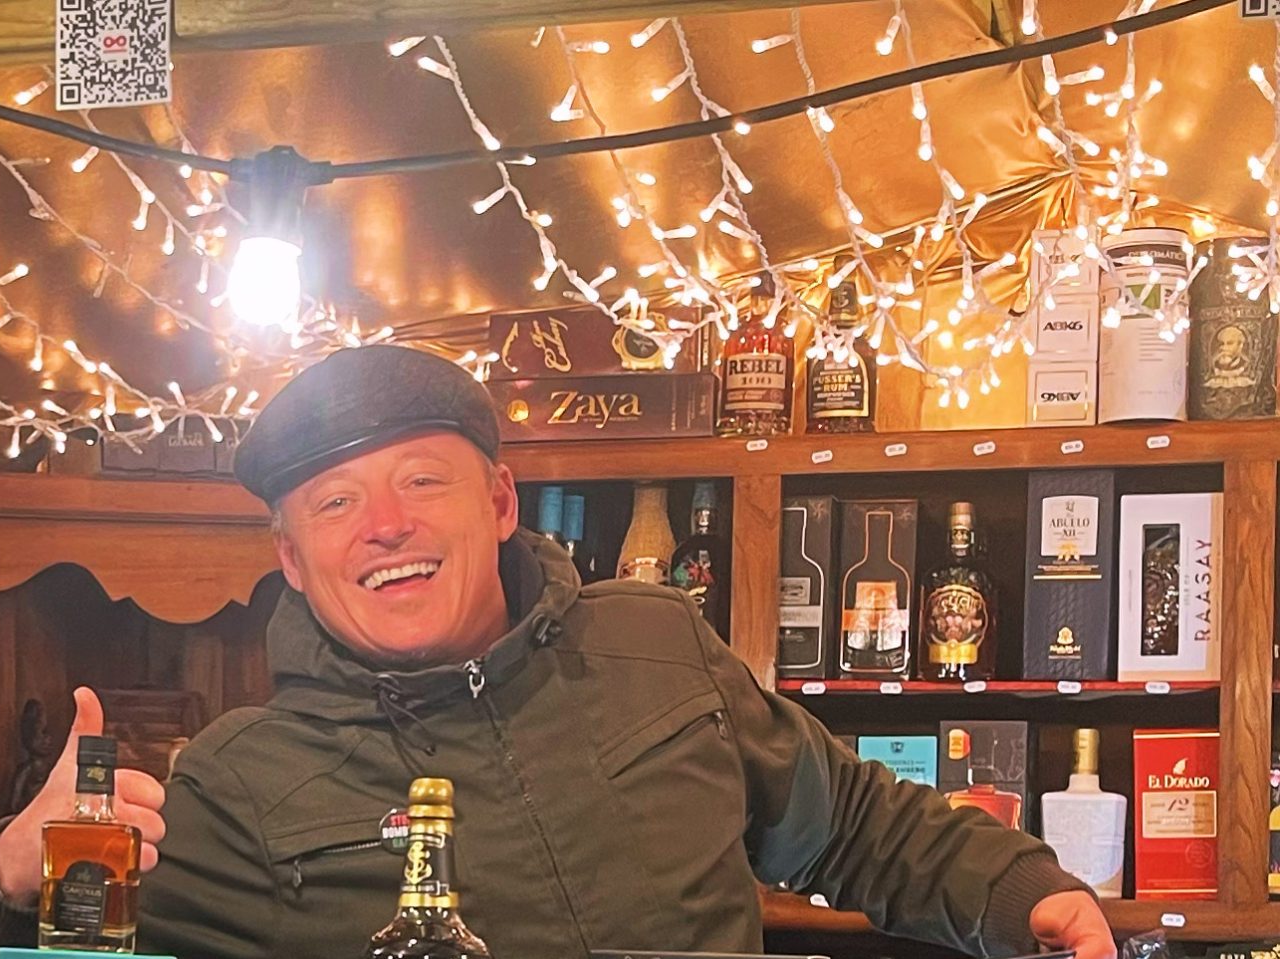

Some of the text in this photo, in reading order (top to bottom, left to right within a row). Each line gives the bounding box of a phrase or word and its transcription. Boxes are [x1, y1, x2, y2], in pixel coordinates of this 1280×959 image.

[728, 356, 784, 376] REBEL
[823, 383, 848, 392] RUM
[547, 388, 643, 429] Zaya
[1049, 517, 1091, 529] ABUELO
[1193, 538, 1213, 642] RAASAY
[1164, 774, 1210, 789] DORADO
